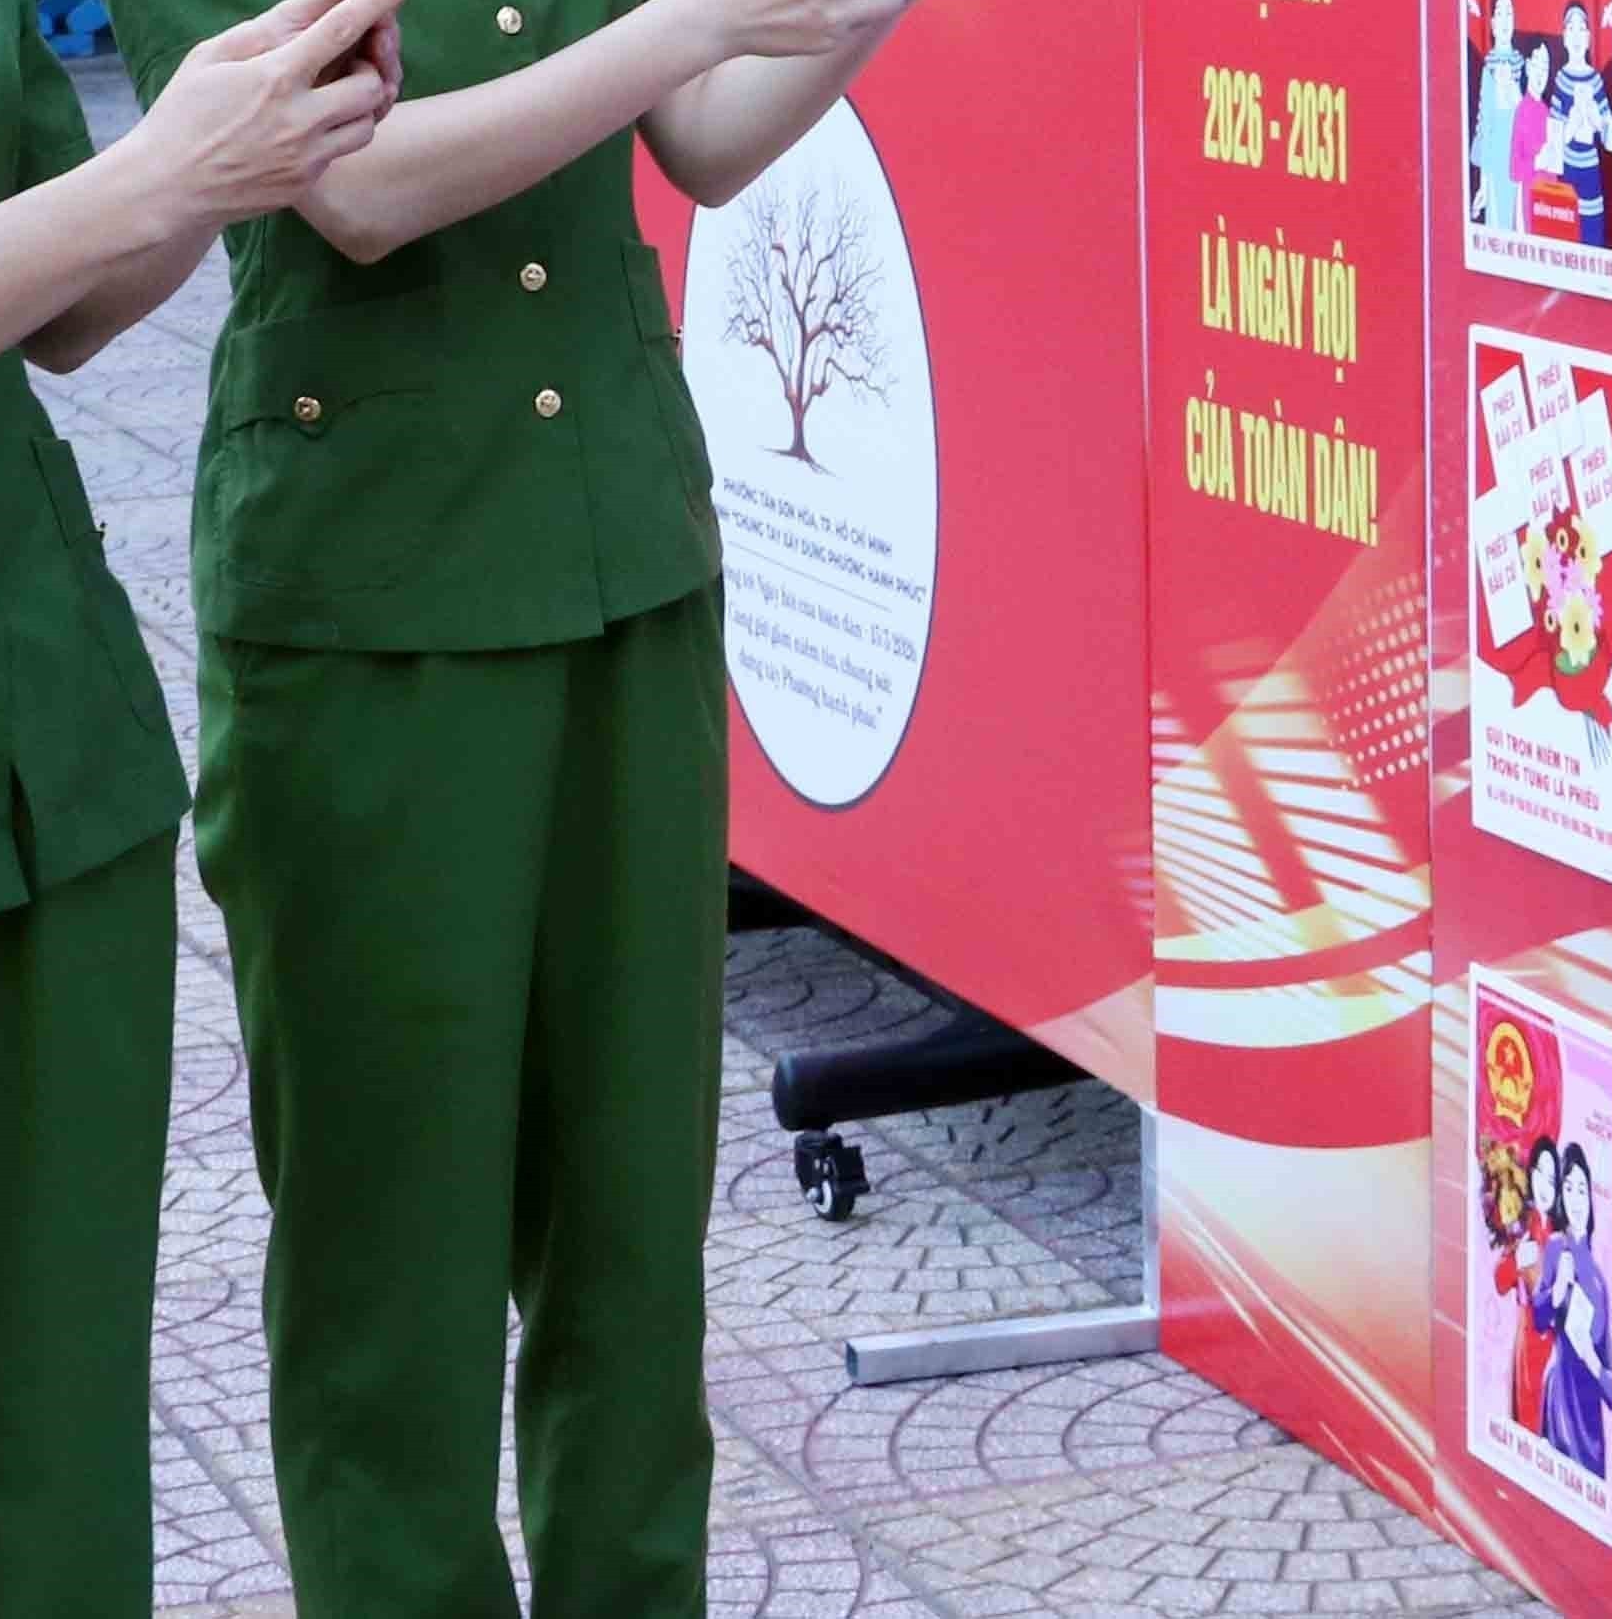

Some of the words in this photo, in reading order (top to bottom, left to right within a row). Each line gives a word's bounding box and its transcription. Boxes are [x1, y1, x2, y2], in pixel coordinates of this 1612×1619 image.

[1203, 65, 1263, 169] 2026
[1269, 121, 1280, 143] -
[1287, 78, 1348, 184] 2031
[1200, 215, 1233, 335] LÀ
[1237, 228, 1306, 351] NGÀY
[1311, 240, 1358, 384] HỘI
[1185, 369, 1236, 501] CỦA
[1240, 399, 1308, 534] TOÀN
[1312, 419, 1379, 548] DÂN!
